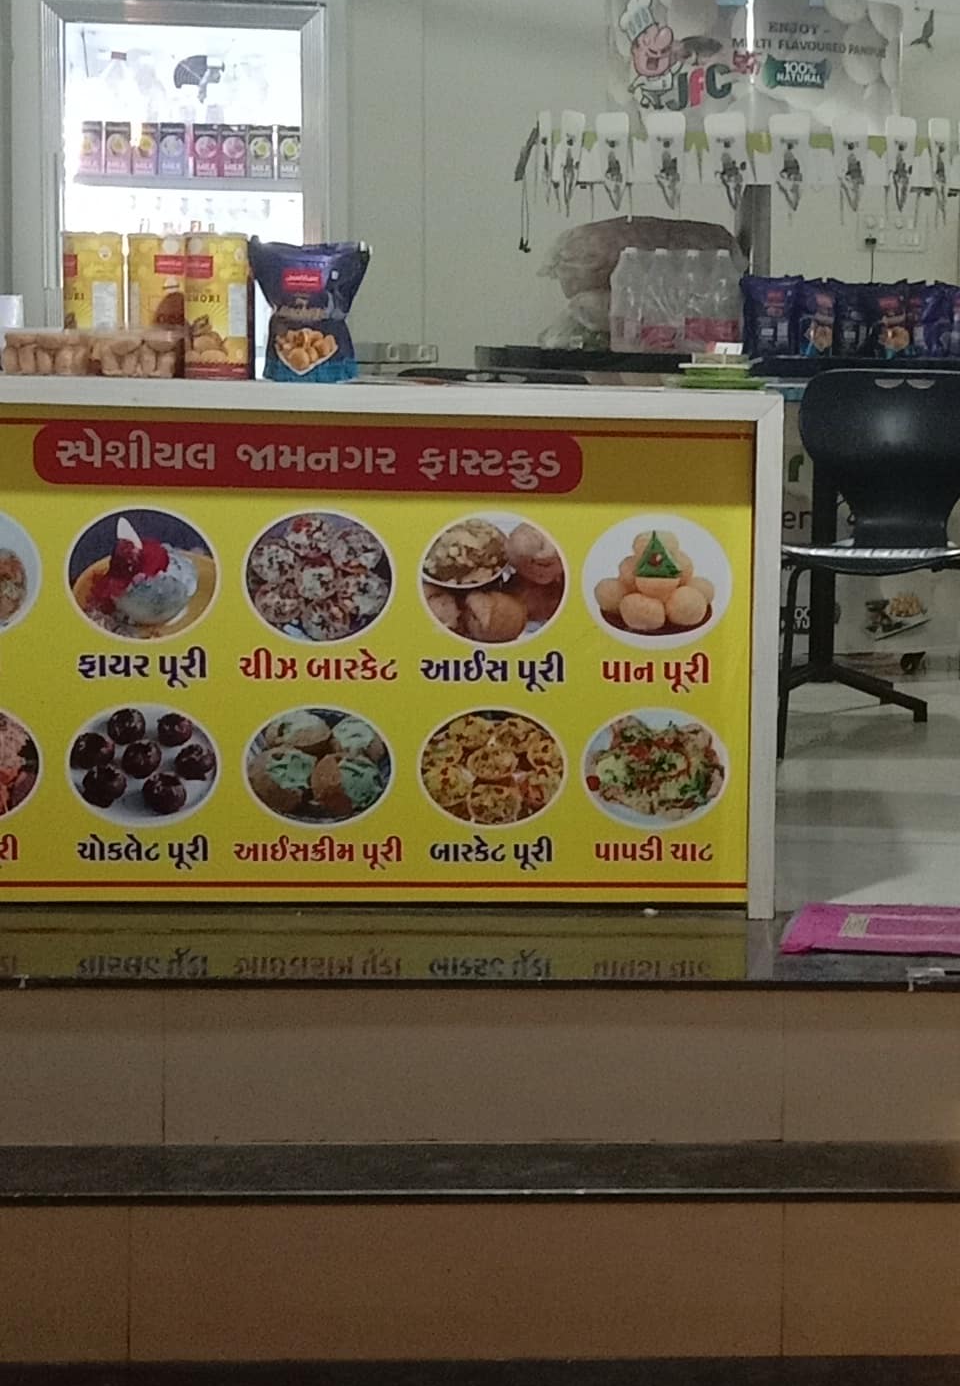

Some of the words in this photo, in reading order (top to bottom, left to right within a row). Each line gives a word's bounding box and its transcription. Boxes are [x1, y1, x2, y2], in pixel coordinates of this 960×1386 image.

[732, 38, 772, 49] MLTI
[778, 39, 846, 54] FLAVOURED
[768, 21, 819, 35] ENJOY
[776, 73, 823, 84] NATURAL
[784, 62, 816, 75] 100%
[56, 429, 216, 470] સ્પેશીયલ
[236, 443, 396, 474] જામનગર
[77, 653, 150, 679] ફાયર
[158, 645, 207, 689] પૂરી
[239, 647, 298, 680] ચીઝ
[306, 648, 398, 681] બાસ્કેટ
[420, 649, 508, 682] આઈસ
[517, 651, 565, 693] પૂરી
[602, 660, 653, 683] પાન
[663, 652, 710, 694] પૂરી
[77, 833, 160, 861] ચોકલેટ
[168, 834, 209, 870] પૂરી
[233, 834, 355, 862] આઈસક્રીમ
[362, 835, 403, 871] પૂરી
[429, 834, 506, 862] બાસ્કેટ
[513, 835, 552, 870] પૂરી
[595, 836, 663, 862] પાપડી
[670, 842, 714, 863] ચાટ
